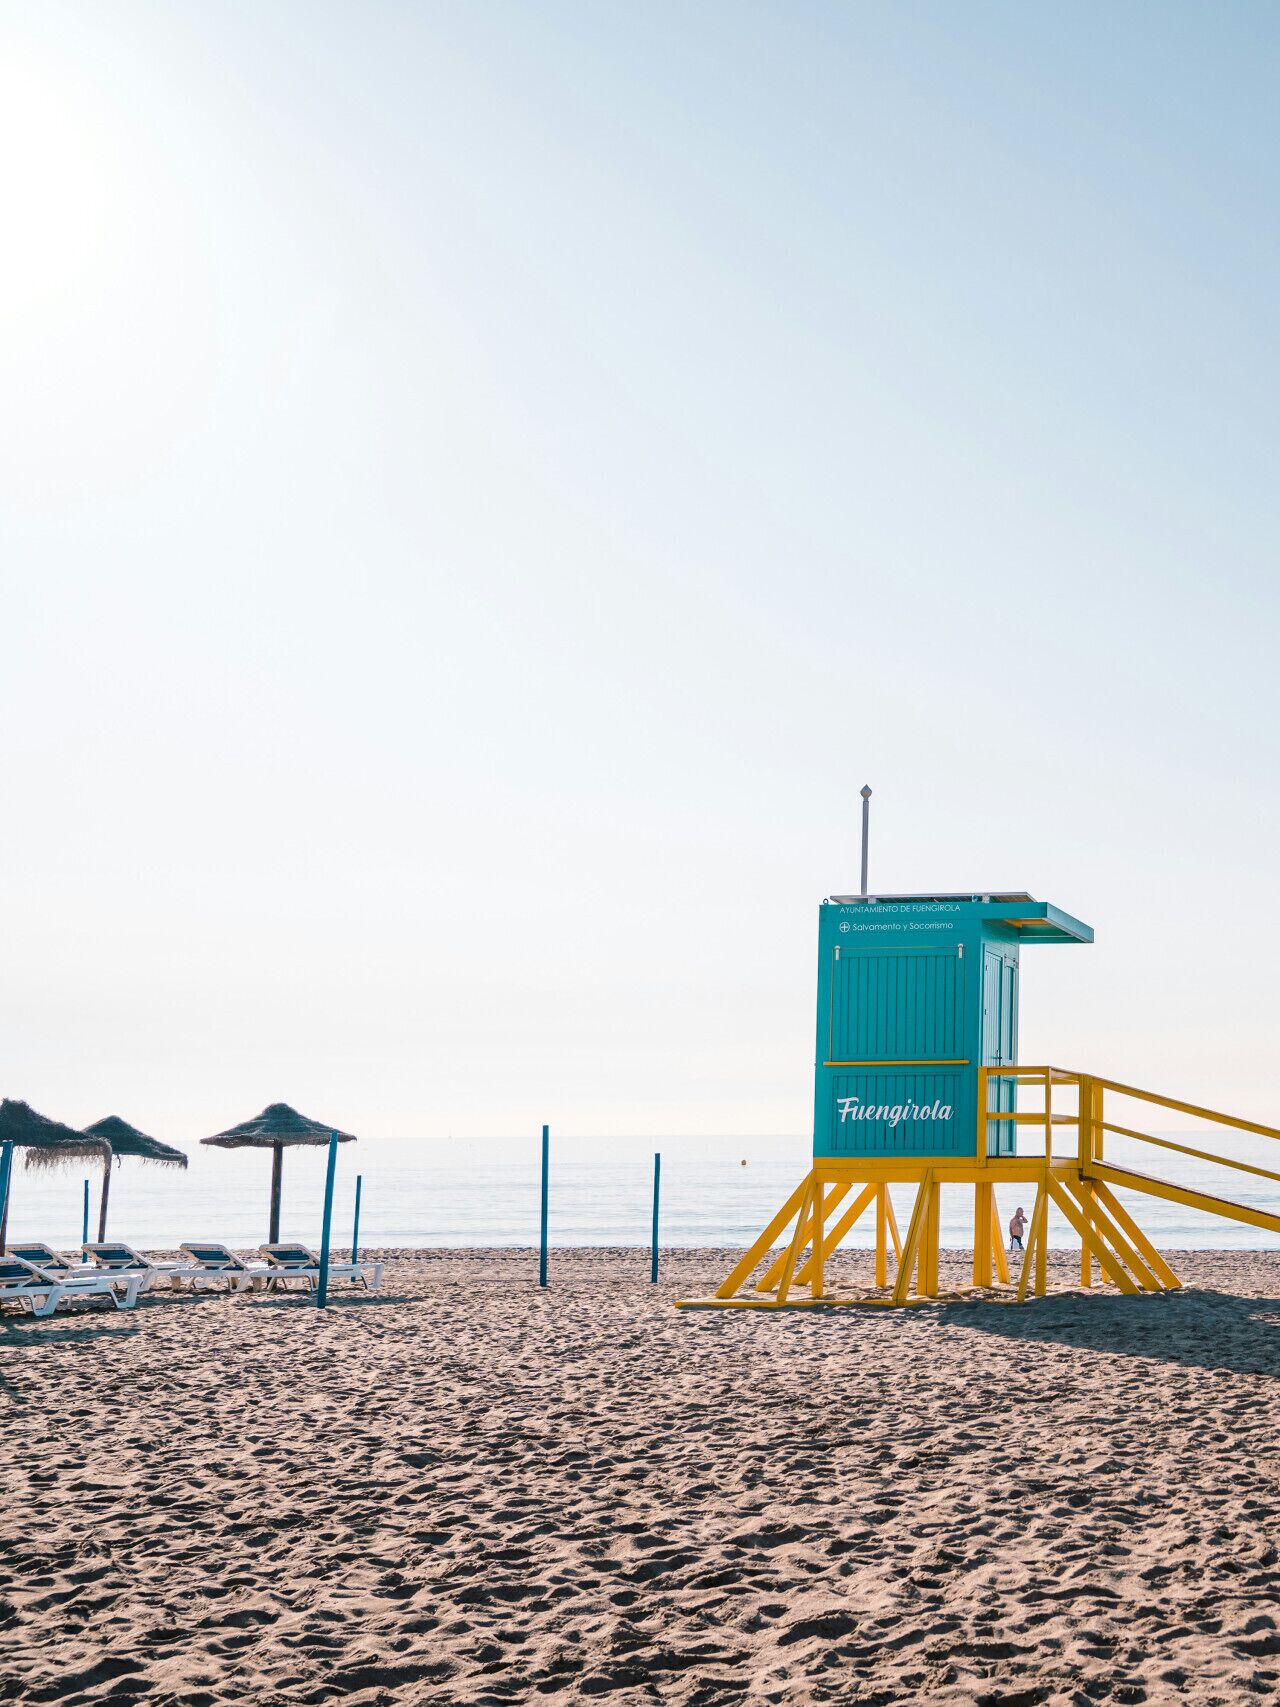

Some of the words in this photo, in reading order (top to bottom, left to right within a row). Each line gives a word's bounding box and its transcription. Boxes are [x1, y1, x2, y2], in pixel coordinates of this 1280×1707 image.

[840, 906, 898, 914] AYUNTAMIENTO
[900, 905, 910, 913] DE
[913, 904, 961, 912] FUENGIROLA
[853, 923, 901, 931] Salvamento
[909, 922, 953, 930] Socorrismo
[837, 1097, 954, 1127] Fuengirola
